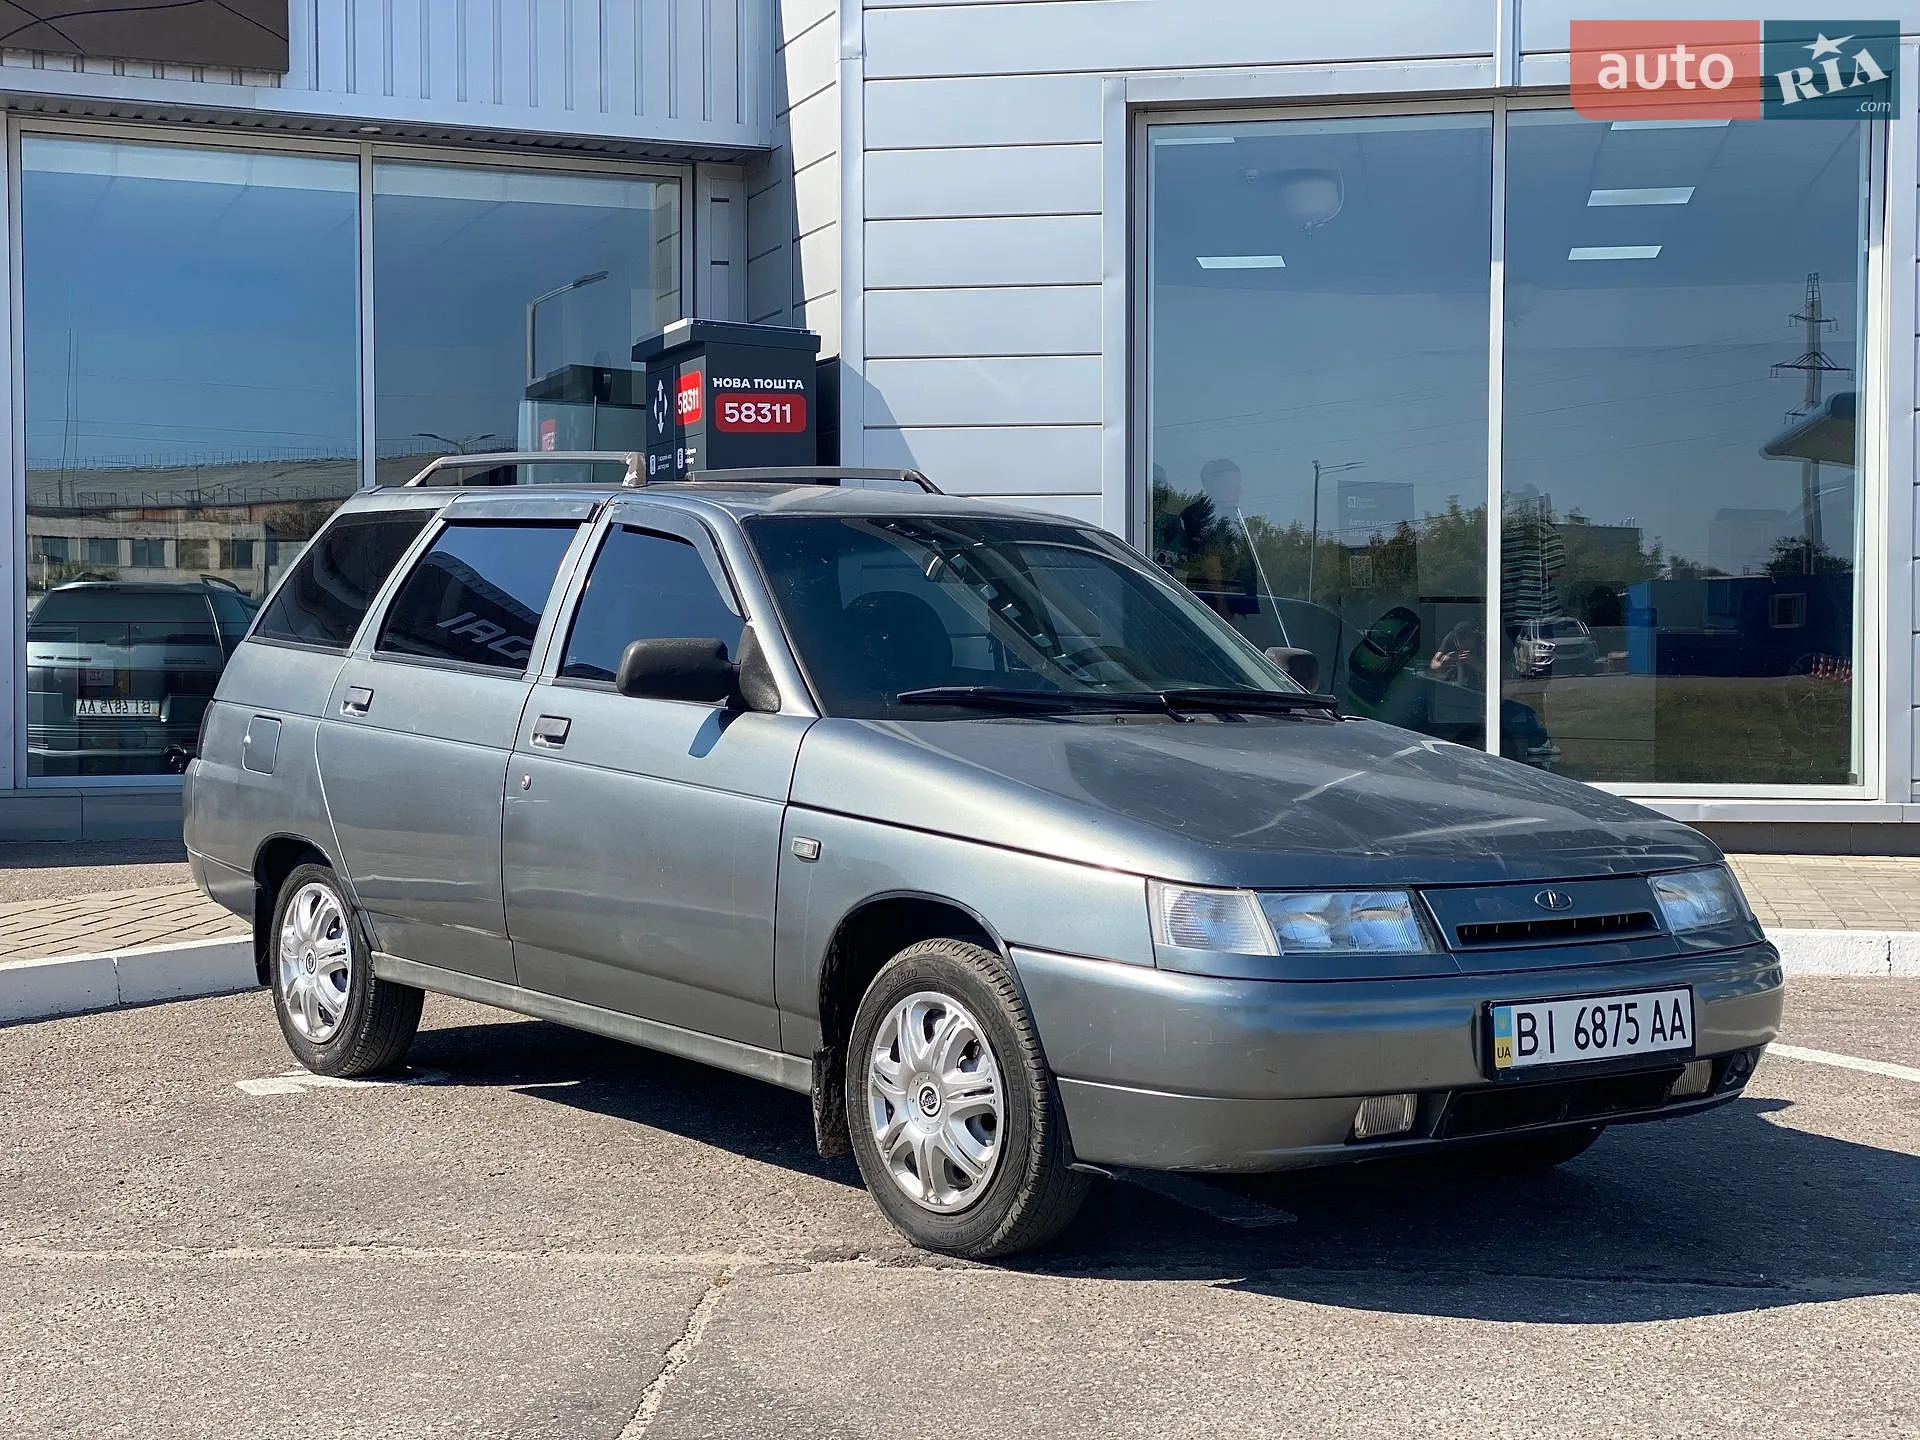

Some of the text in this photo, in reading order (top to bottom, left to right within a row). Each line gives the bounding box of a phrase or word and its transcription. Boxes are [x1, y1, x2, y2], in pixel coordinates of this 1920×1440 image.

[713, 377, 805, 390] НОВА ПОШТА
[677, 387, 699, 415] 58311
[724, 402, 792, 424] 58311
[1516, 998, 1687, 1057] BI 6875 AA
[1497, 1046, 1512, 1059] UA
